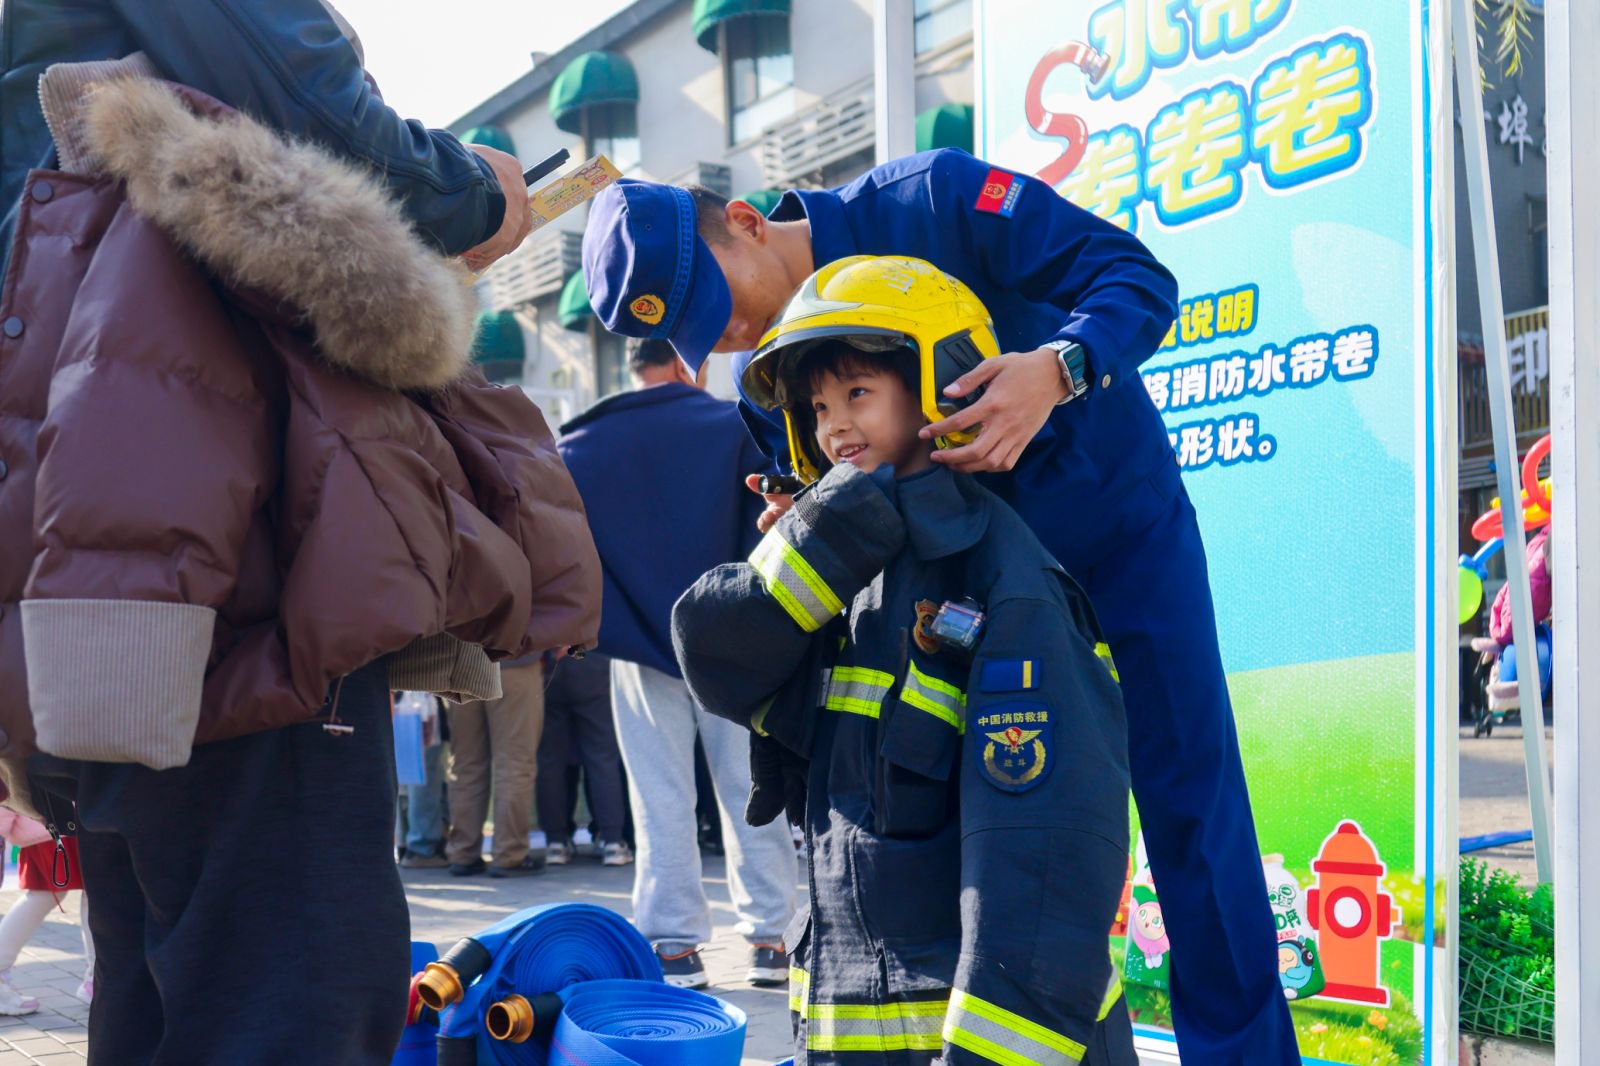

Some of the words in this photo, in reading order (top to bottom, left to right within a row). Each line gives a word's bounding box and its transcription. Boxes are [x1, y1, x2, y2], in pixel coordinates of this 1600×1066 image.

[1144, 331, 1373, 411] 将消防水带卷
[1505, 327, 1548, 394] 印
[1169, 418, 1272, 467] 形状。
[977, 710, 1048, 727] 中国消防救援
